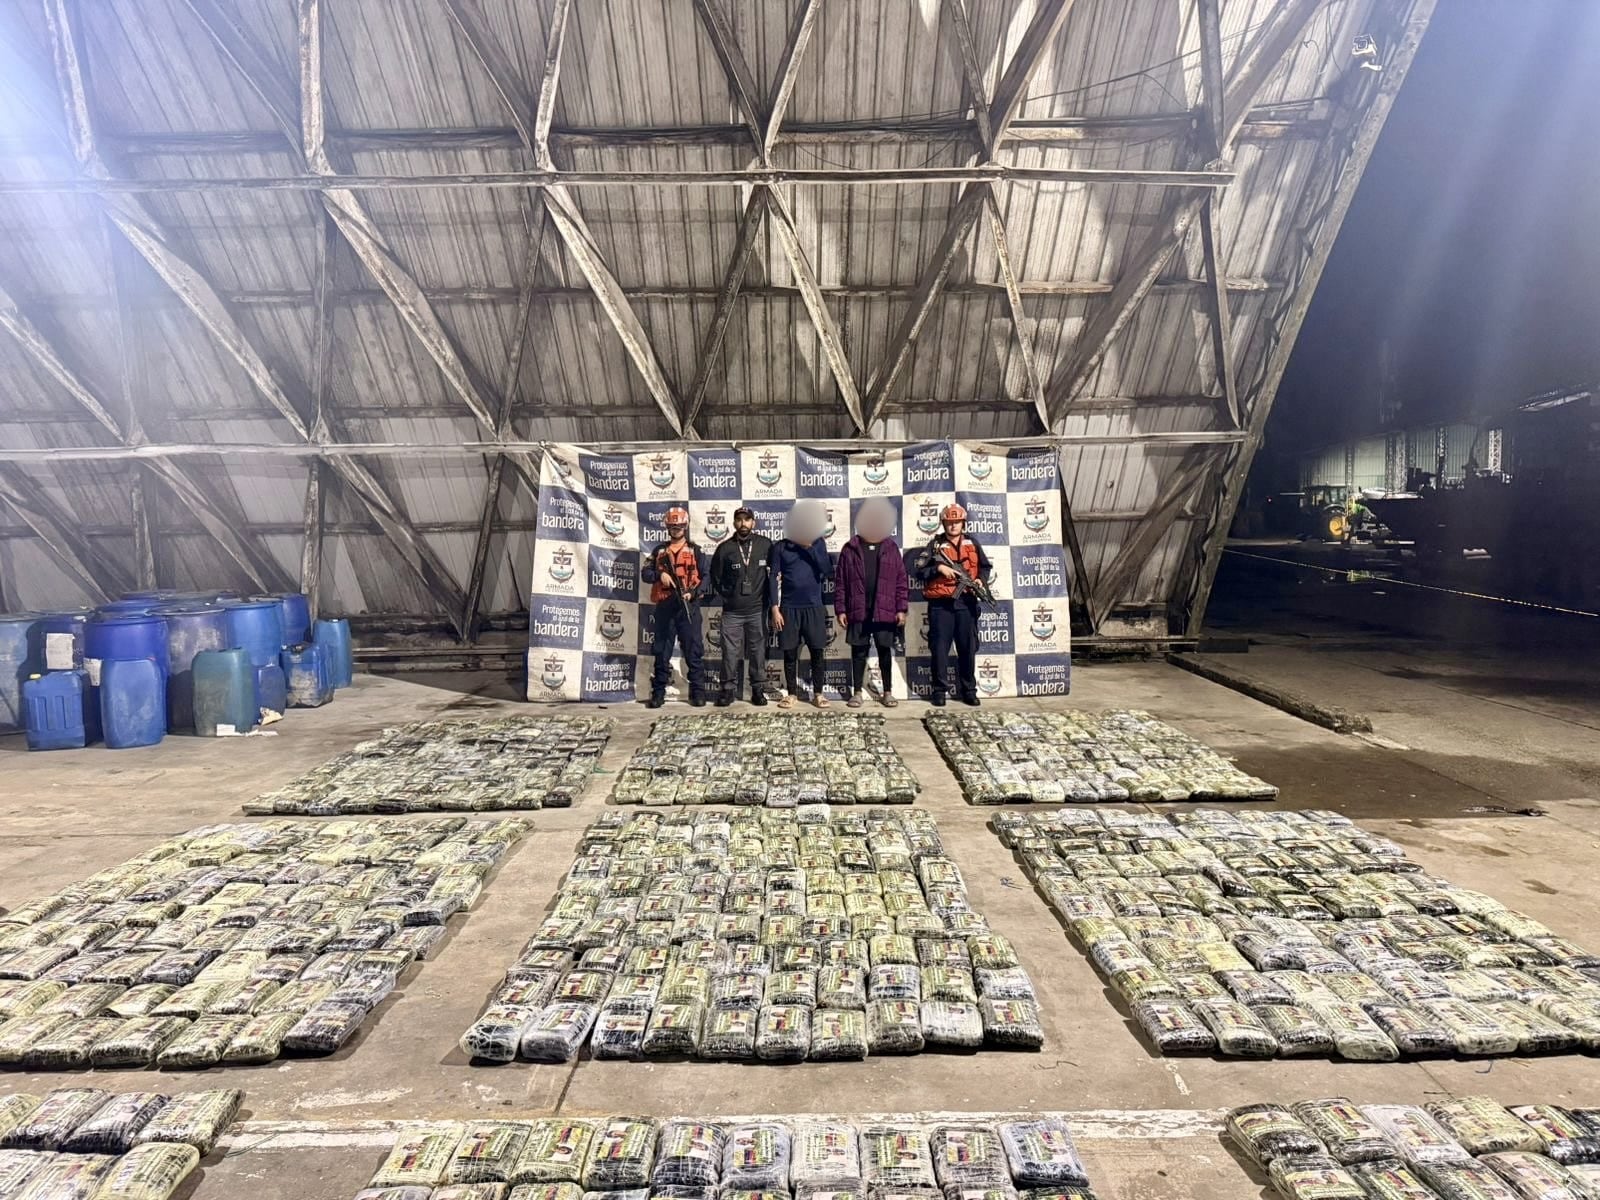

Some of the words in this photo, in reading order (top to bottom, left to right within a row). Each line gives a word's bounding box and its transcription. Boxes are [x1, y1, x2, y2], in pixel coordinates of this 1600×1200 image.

[590, 460, 628, 470] Protegemos
[698, 457, 736, 467] Protegemos
[692, 472, 736, 488] bandera
[800, 470, 844, 486] bandera
[907, 464, 949, 482] bandera
[1011, 464, 1056, 480] bandera
[588, 473, 630, 491] bandera
[966, 502, 1002, 512] Protegemos
[541, 511, 585, 530] bandera
[599, 556, 635, 570] Protegemos
[1022, 556, 1059, 566] Protegemos
[592, 571, 634, 590] bandera
[1016, 571, 1061, 587] bandera
[542, 604, 580, 617] Protegemos
[534, 619, 579, 638] bandera
[593, 662, 630, 672] Protegemos
[1028, 665, 1065, 674] Protegemos
[585, 676, 629, 692] bandera
[1021, 680, 1065, 696] bandera
